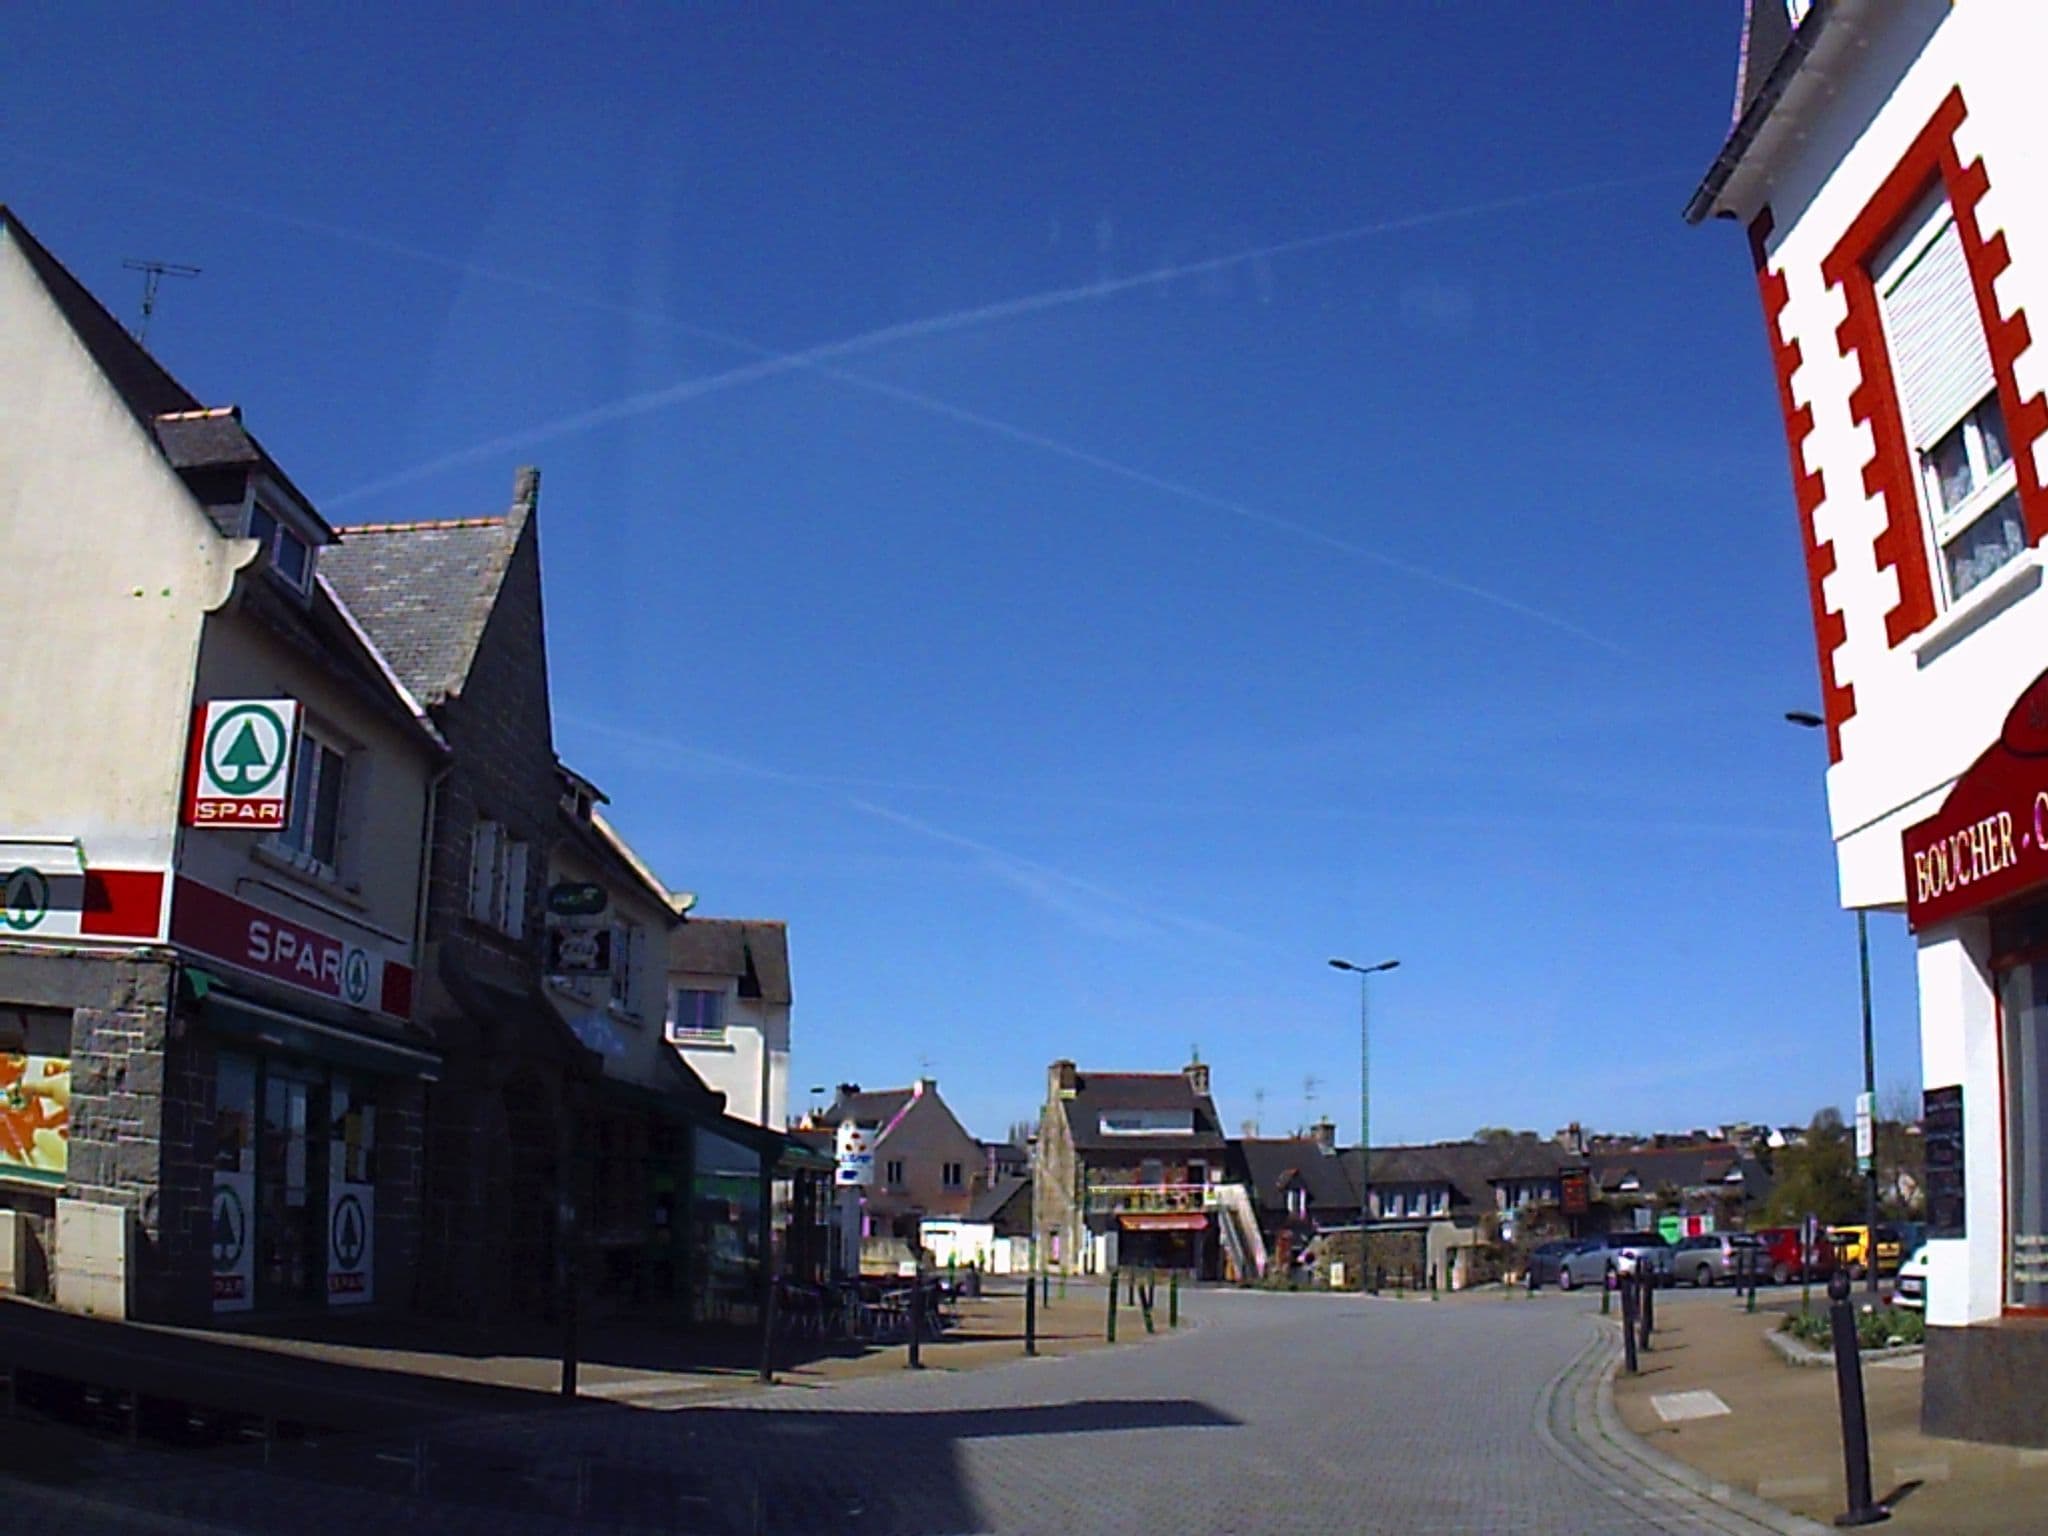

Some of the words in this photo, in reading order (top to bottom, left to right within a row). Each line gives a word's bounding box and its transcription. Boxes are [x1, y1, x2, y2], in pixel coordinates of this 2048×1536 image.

[198, 802, 279, 819] SPAR
[1914, 811, 2017, 904] BOUCHER
[247, 919, 341, 985] SPAR
